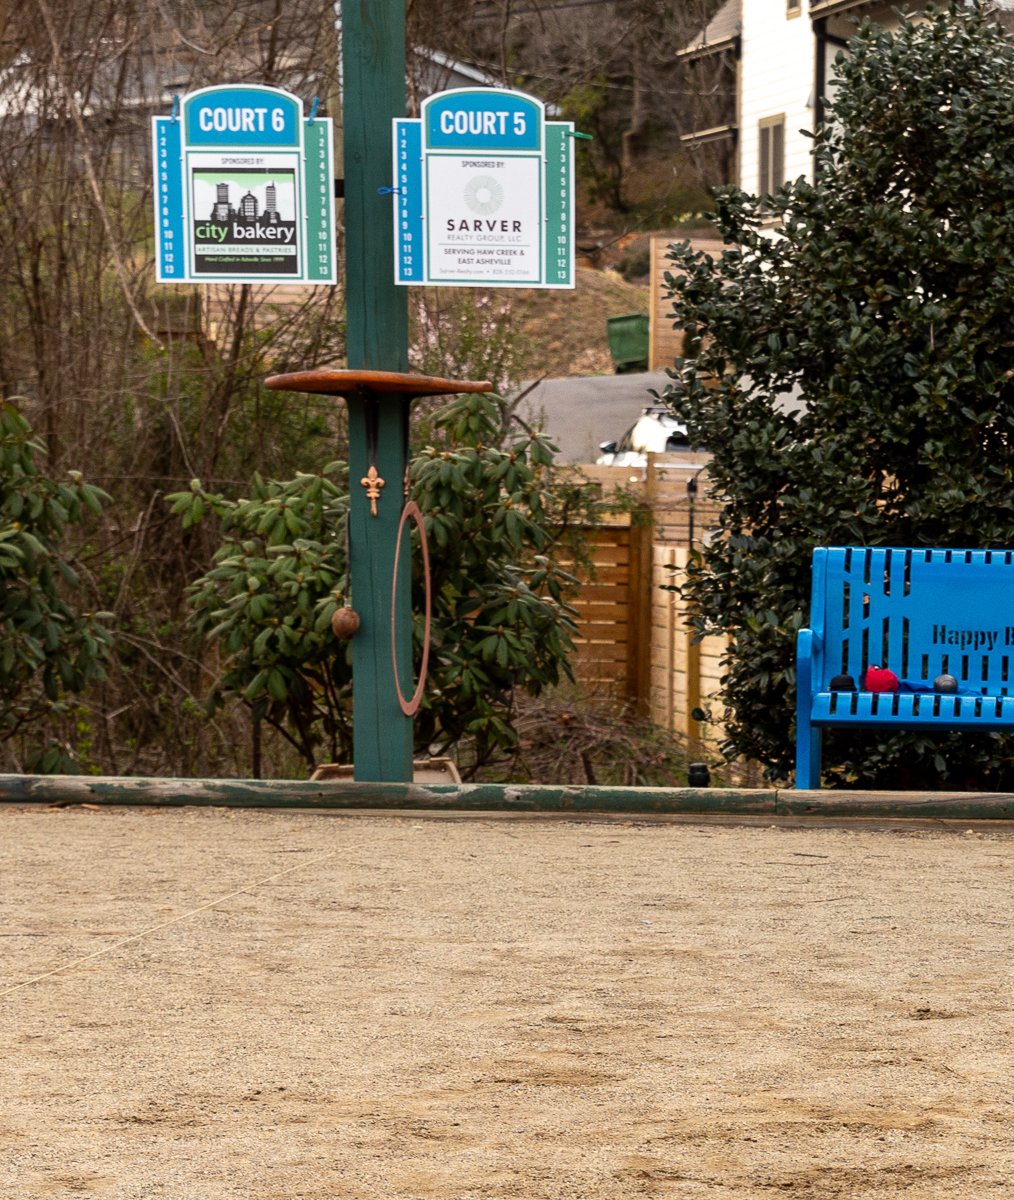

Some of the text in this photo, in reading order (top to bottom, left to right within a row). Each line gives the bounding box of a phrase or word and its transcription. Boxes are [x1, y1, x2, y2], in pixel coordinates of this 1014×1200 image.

[199, 108, 284, 132] COURT 6
[440, 110, 526, 135] COURT 5
[160, 125, 166, 134] 1
[561, 131, 565, 139] 1
[160, 137, 167, 146] 2
[319, 138, 325, 147] 2
[560, 142, 566, 151] 2
[160, 149, 167, 157] 3
[319, 150, 325, 158] 3
[401, 151, 407, 159] 3
[560, 154, 566, 163] 3
[161, 160, 167, 169] 4
[319, 162, 325, 171] 4
[401, 163, 407, 171] 4
[461, 160, 495, 168] SPONSORED
[560, 166, 566, 174] 4
[161, 172, 167, 181] 5
[319, 174, 325, 182] 5
[401, 174, 407, 183] 5
[560, 178, 566, 186] 5
[161, 183, 168, 192] 6
[320, 185, 326, 194] 6
[401, 186, 408, 195] 6
[560, 189, 566, 198] 6
[162, 195, 168, 204] 7
[320, 197, 326, 205] 7
[402, 198, 407, 206] 7
[560, 201, 566, 209] 7
[162, 207, 168, 216] 8
[320, 208, 326, 217] 8
[402, 209, 408, 218] 8
[560, 213, 566, 221] 8
[163, 219, 169, 227] 9
[321, 220, 327, 229] 9
[402, 221, 408, 229] 9
[447, 219, 522, 232] SARVER
[195, 223, 294, 243] city bakery
[560, 224, 567, 233] 9
[164, 230, 174, 239] 10
[318, 231, 327, 240] 10
[403, 233, 412, 241] 10
[557, 236, 566, 244] 10
[164, 242, 173, 250] 11
[318, 243, 327, 251] 11
[403, 244, 412, 253] 11
[557, 247, 566, 255] 11
[164, 254, 174, 262] 12
[318, 255, 327, 263] 12
[404, 256, 412, 264] 12
[557, 259, 566, 268] 12
[164, 265, 174, 274] 13
[319, 267, 328, 275] 13
[404, 268, 412, 276] 13
[557, 271, 566, 279] 13
[932, 625, 999, 651] Happy
